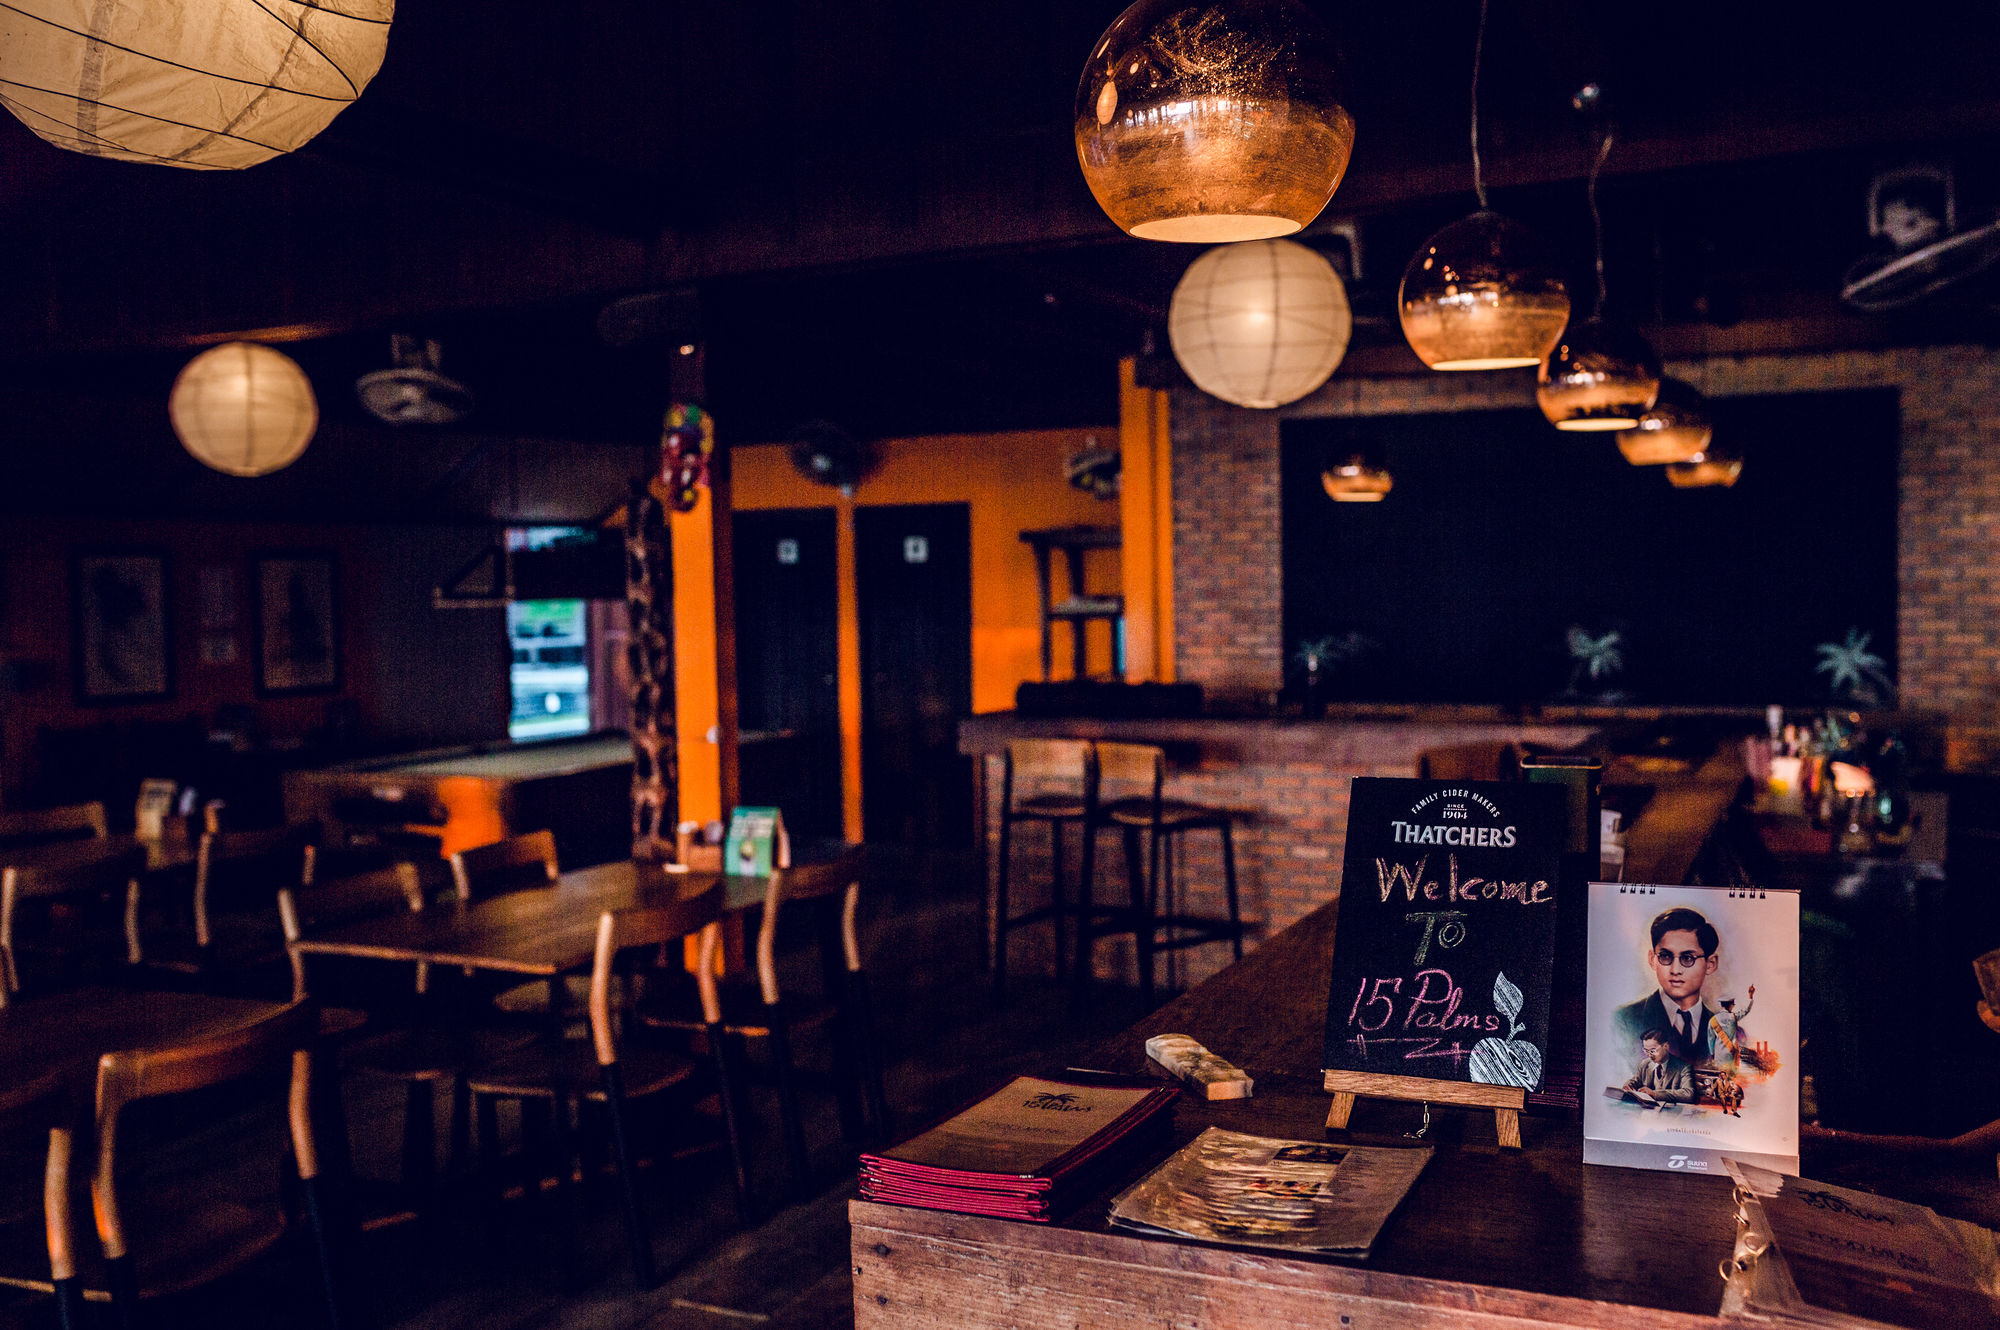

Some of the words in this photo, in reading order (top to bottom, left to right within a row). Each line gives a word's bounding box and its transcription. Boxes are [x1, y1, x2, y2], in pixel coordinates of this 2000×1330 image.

[1411, 792, 1439, 815] FAMILY
[1442, 789, 1469, 798] CIDER
[1471, 792, 1501, 818] MAKERS
[1442, 810, 1469, 820] 1904
[1391, 820, 1517, 848] THATCHERS
[1375, 852, 1553, 905] Welcome
[1347, 977, 1401, 1031] 15
[1403, 968, 1500, 1031] Palms
